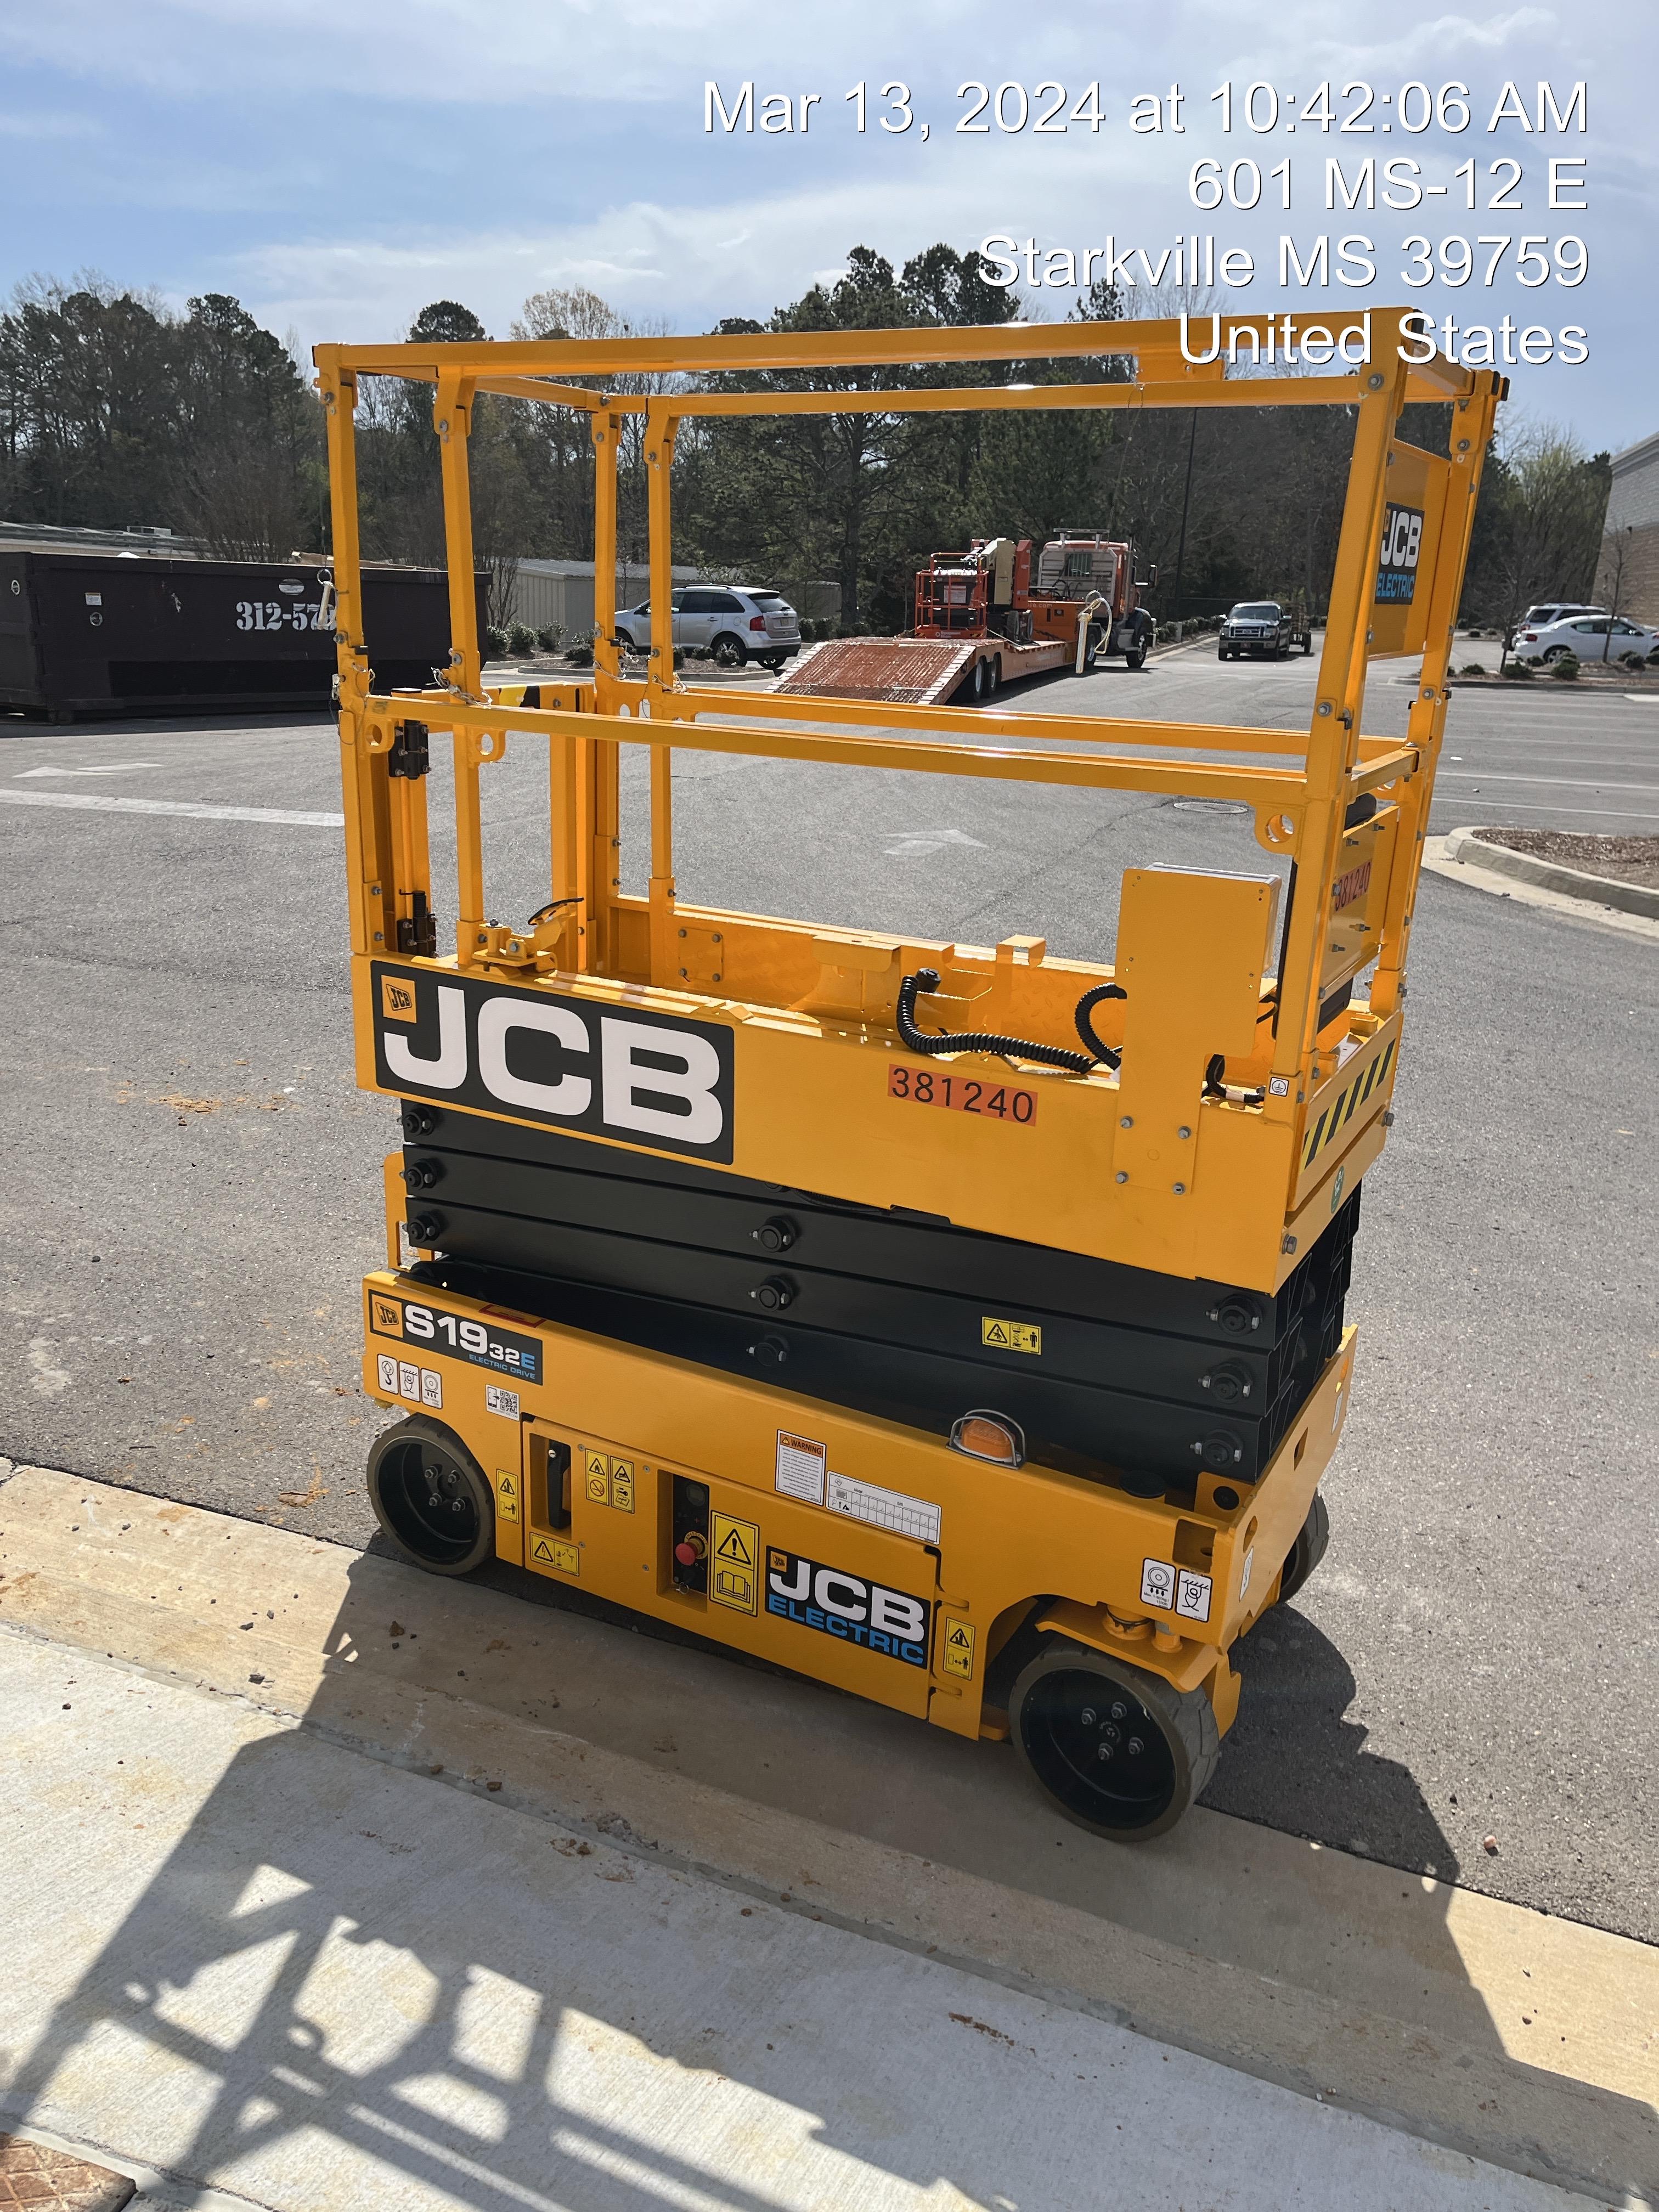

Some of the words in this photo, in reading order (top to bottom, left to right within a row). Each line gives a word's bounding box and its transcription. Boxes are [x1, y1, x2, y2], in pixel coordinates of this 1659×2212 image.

[1380, 510, 1422, 567] JCB
[1376, 573, 1415, 597] ELECTRIC
[1335, 862, 1370, 911] 381240
[390, 987, 410, 1009] JCB
[384, 985, 724, 1145] JCB
[891, 1068, 1033, 1123] 381240
[379, 1306, 398, 1324] JCB
[469, 1353, 508, 1372] ELECTRIC
[510, 1367, 536, 1380] DRIVE
[791, 1439, 821, 1455] WARNING
[770, 1560, 924, 1642] JCB
[769, 1593, 924, 1664] ELECTRIC
